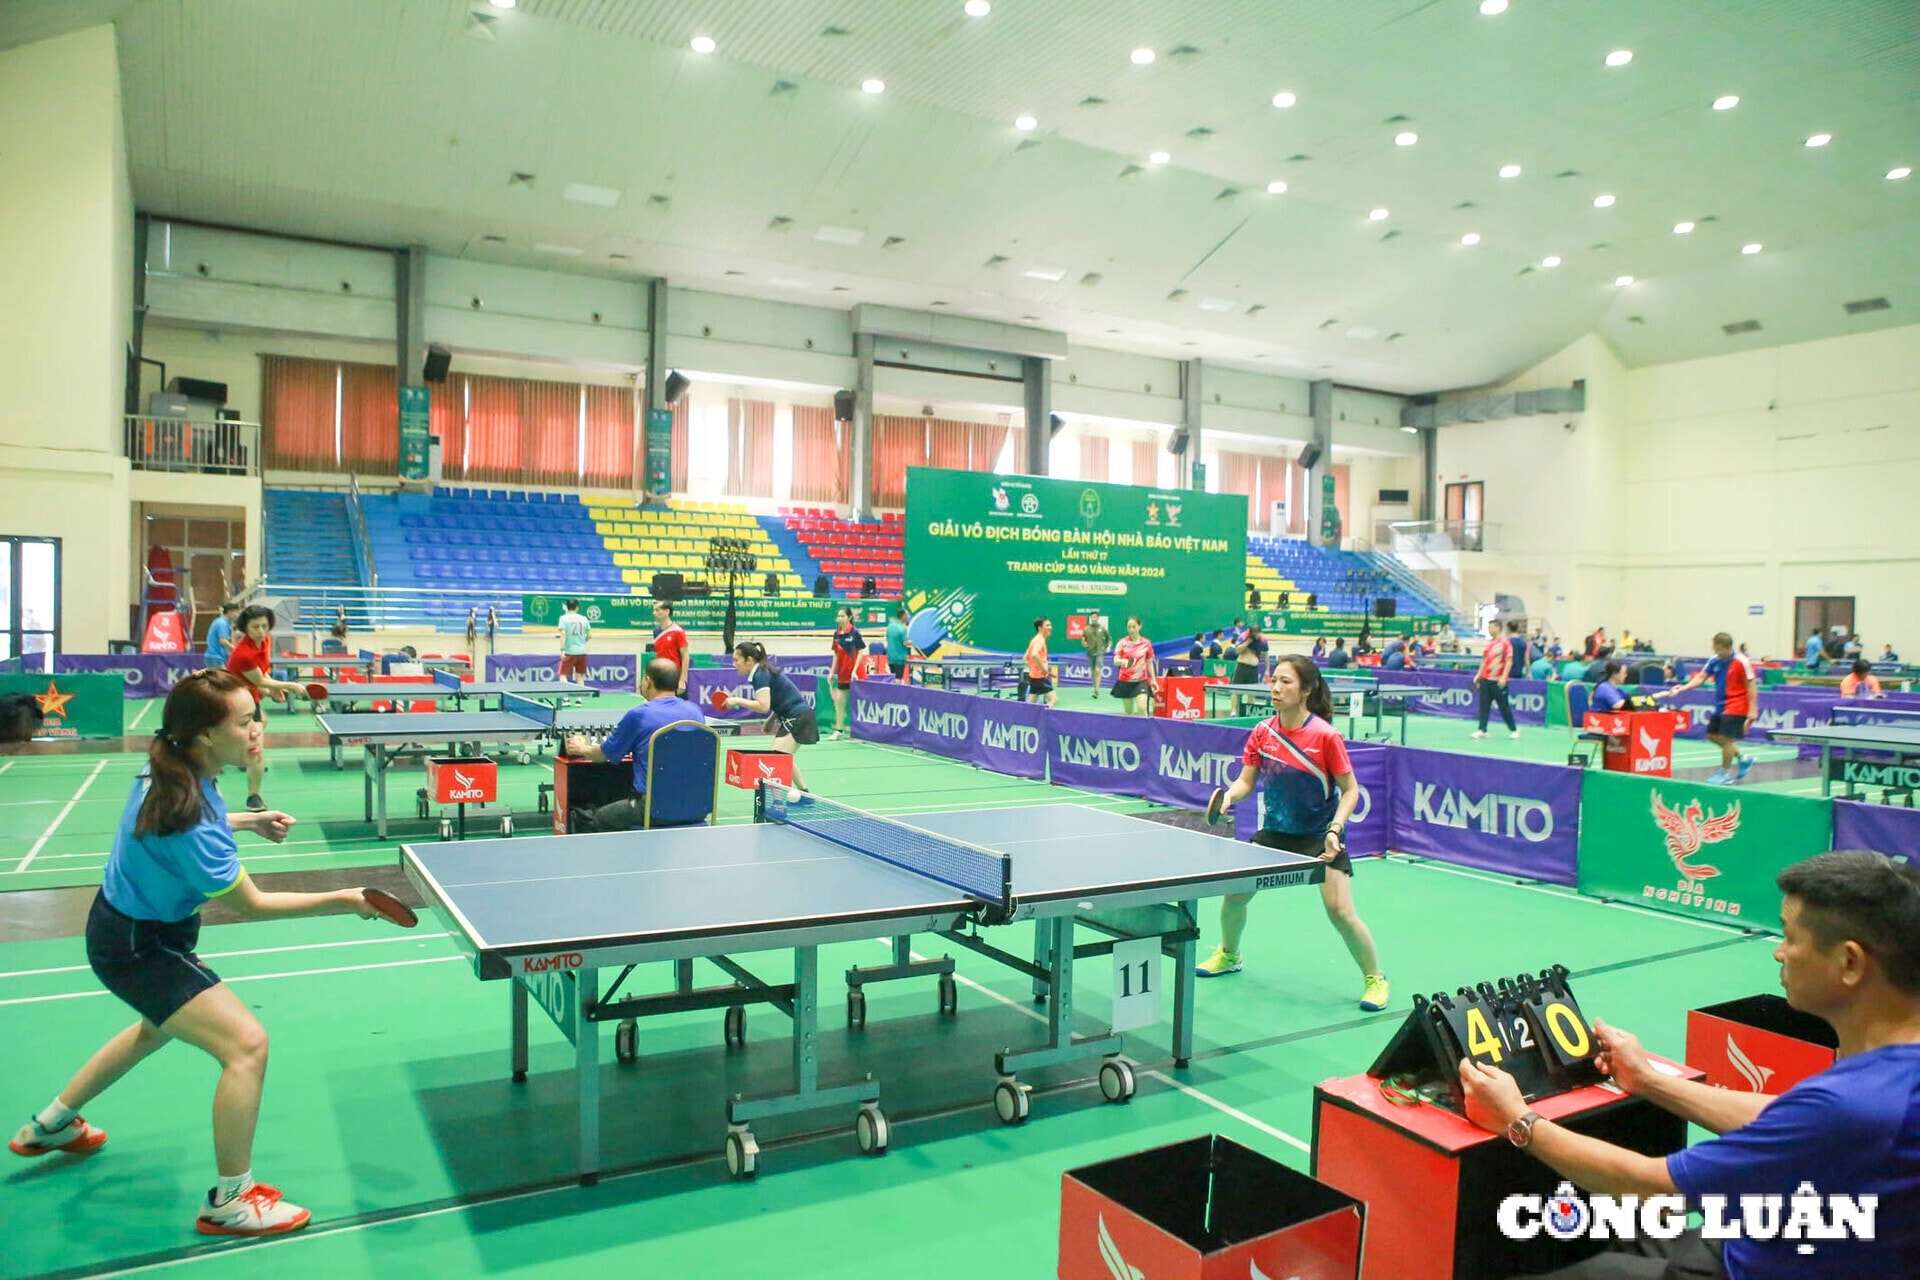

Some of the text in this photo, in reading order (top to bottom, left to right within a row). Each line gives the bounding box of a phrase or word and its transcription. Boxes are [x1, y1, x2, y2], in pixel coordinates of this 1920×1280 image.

[928, 519, 1229, 553] GIẢI VÔ ĐỊCH BÓNG BÀN HỘI NHÀ BÁO VIỆT NAM
[1007, 561, 1043, 572] TRANH
[1044, 560, 1066, 573] CÚP
[1067, 563, 1088, 574] SAO
[1090, 562, 1117, 575] VÀNG
[1141, 566, 1165, 577] 2024
[611, 598, 628, 607] GIẢI
[495, 667, 554, 682] KAMITO
[857, 699, 911, 728] KAMITO
[918, 708, 968, 740] KAMITO
[1172, 709, 1200, 719] KAMITO
[981, 719, 1039, 754] KAMITO
[1058, 735, 1141, 772] KAMITO
[1844, 763, 1920, 788] KAMITO
[450, 789, 484, 799] KAMITO
[1414, 781, 1554, 842] KAMITO
[1256, 872, 1304, 889] PREMIUM
[524, 953, 583, 972] KAMITO
[1119, 960, 1152, 998] 11
[1467, 1008, 1503, 1063] 4
[1514, 1017, 1535, 1048] 2
[1546, 1003, 1590, 1057] 0
